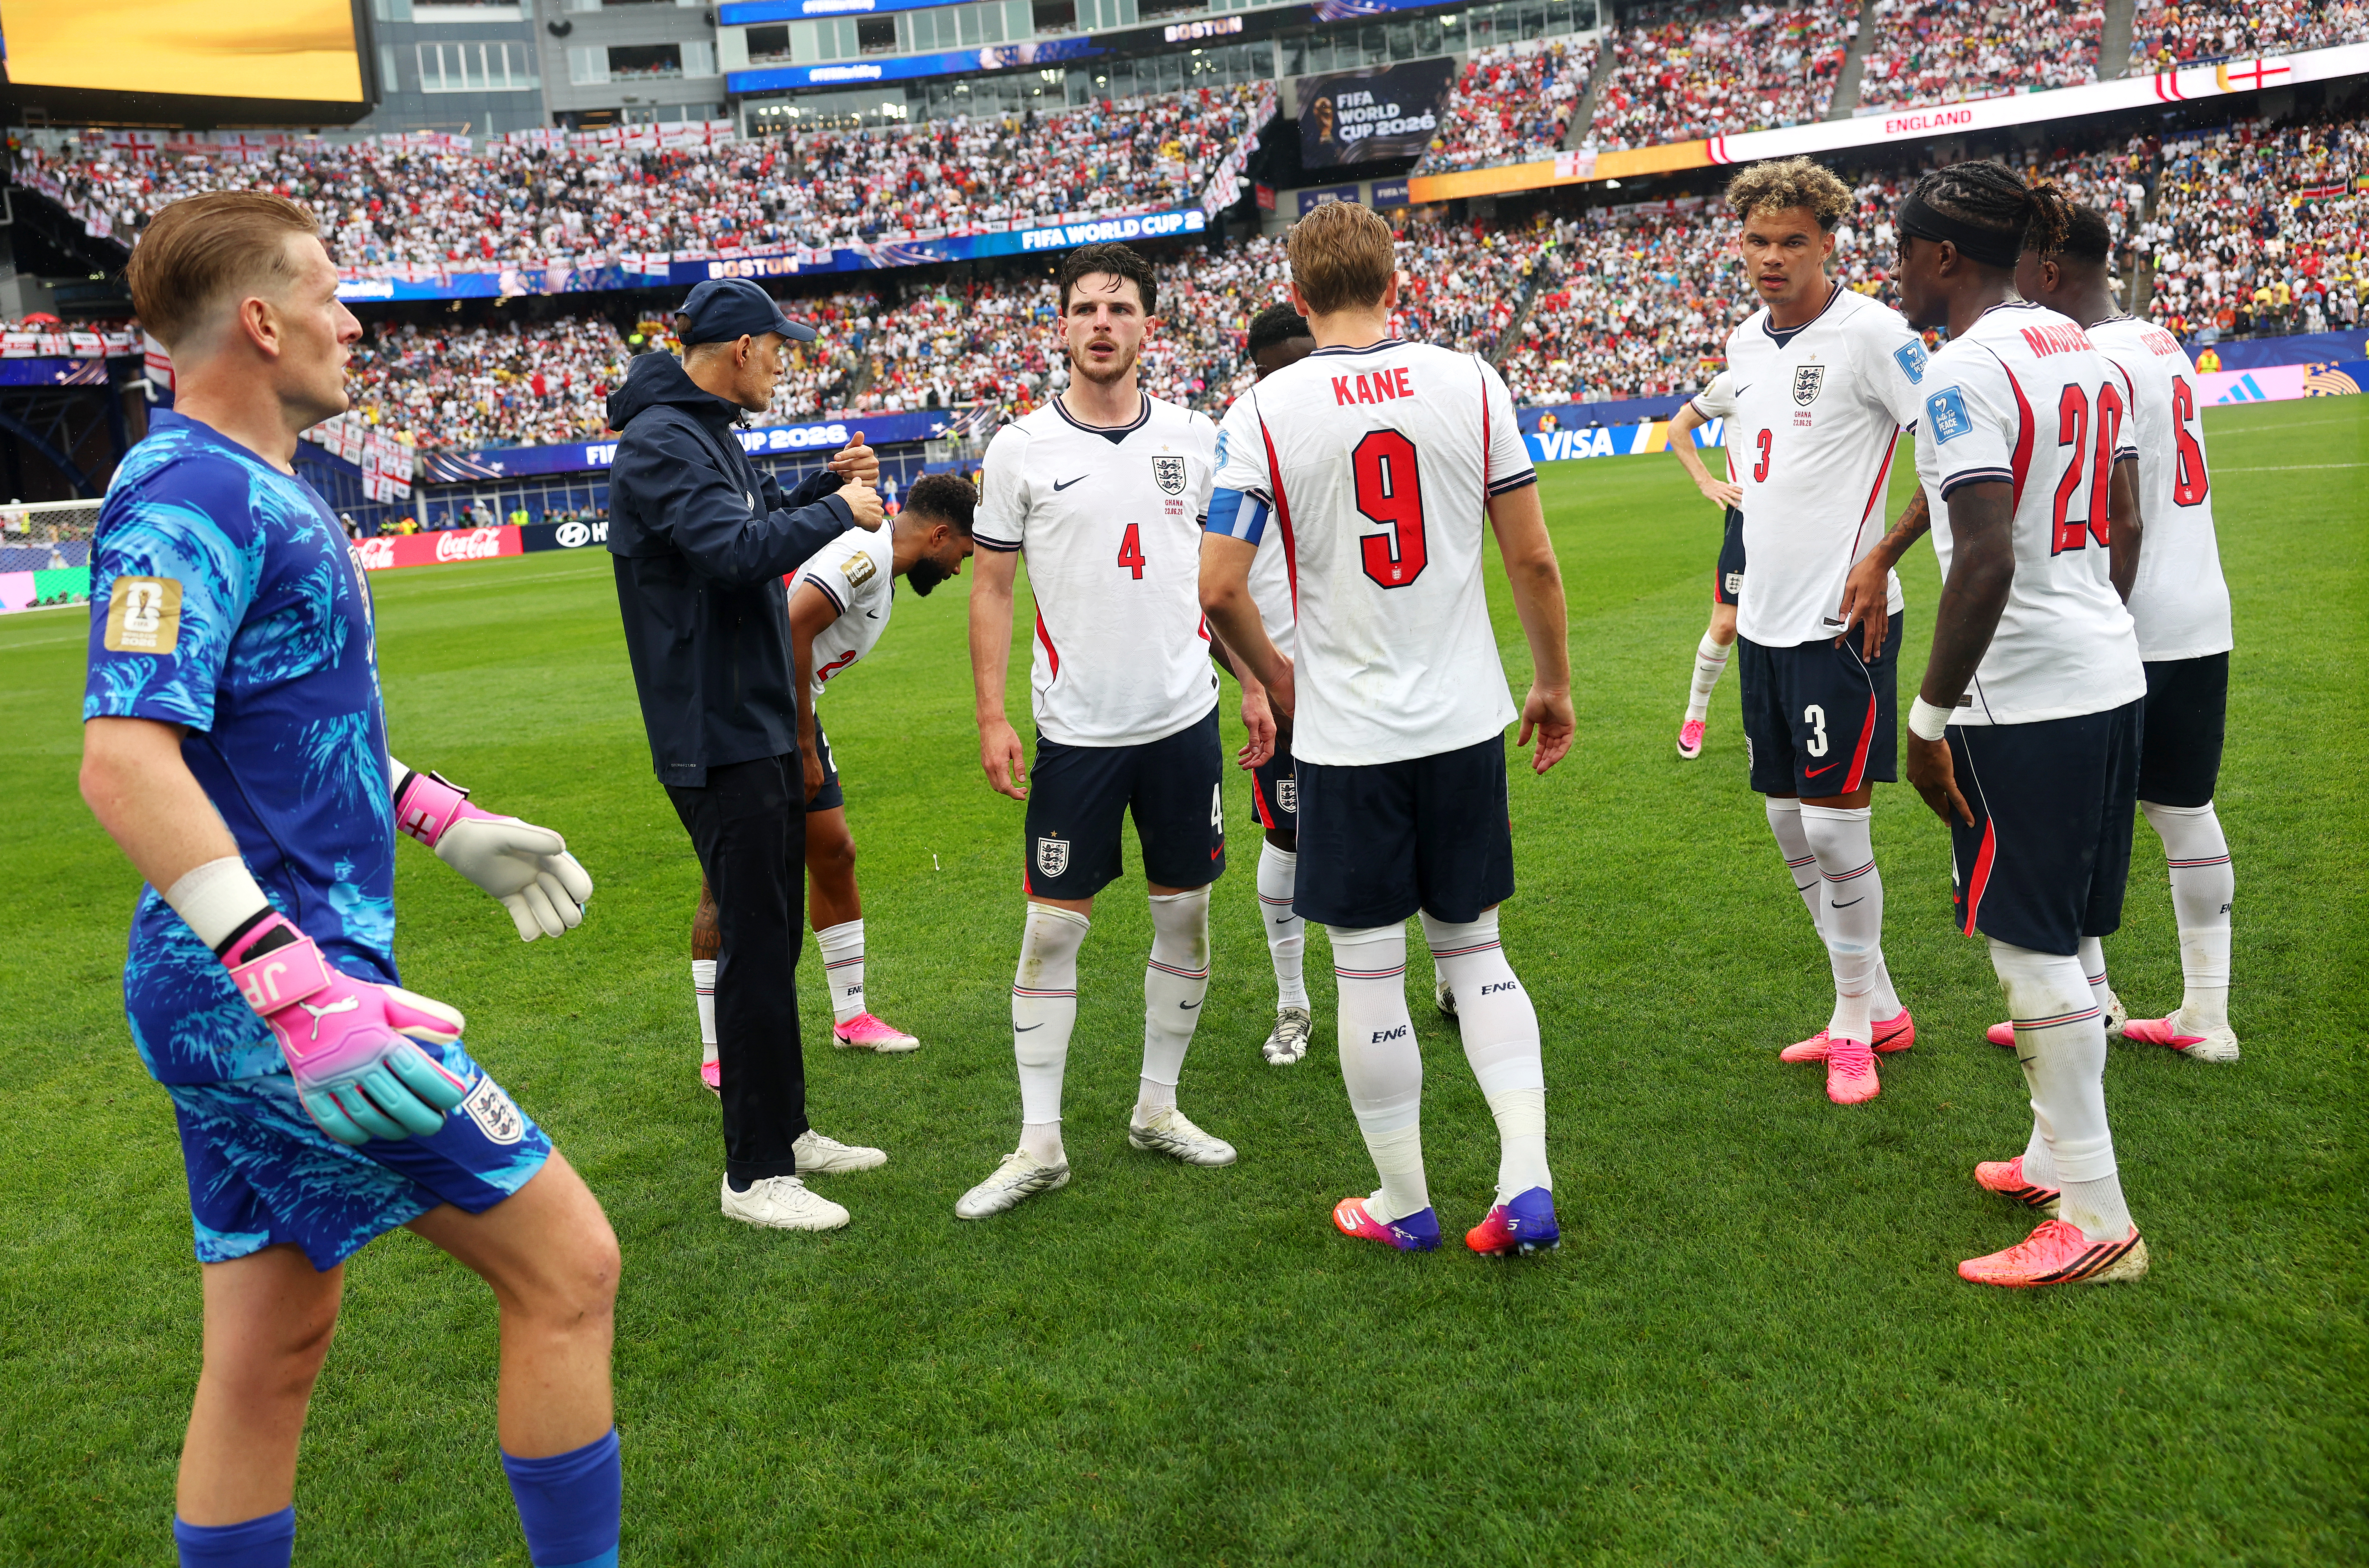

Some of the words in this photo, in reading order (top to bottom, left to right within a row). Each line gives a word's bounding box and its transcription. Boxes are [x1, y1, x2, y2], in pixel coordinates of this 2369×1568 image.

[1165, 15, 1243, 42] BOSTON
[1336, 90, 1375, 109] FIFA
[1337, 103, 1401, 125] WORLD
[1338, 122, 1375, 142] CUP
[1375, 114, 1437, 136] 2026
[1886, 110, 1971, 134] ENGLAND
[1021, 227, 1066, 250] FIFA
[1065, 219, 1140, 244] WORLD
[1141, 213, 1183, 235] CUP
[1184, 210, 1204, 230] 2
[708, 255, 799, 280] BOSTON
[1331, 367, 1414, 406] KANE
[769, 424, 848, 449] 2026
[1938, 418, 1958, 432] PEACE
[1532, 427, 1615, 461] VISA
[1753, 428, 1773, 482] 3
[2172, 374, 2209, 507] 6
[2051, 381, 2123, 557] 20
[1351, 428, 1428, 590] 9
[1118, 523, 1146, 580] 4
[816, 650, 859, 683] 2
[1804, 704, 1828, 757] 3
[1211, 782, 1223, 835] 4
[847, 985, 863, 996] ENG
[1481, 981, 1516, 995] ENG
[1372, 1024, 1407, 1044] ENG
